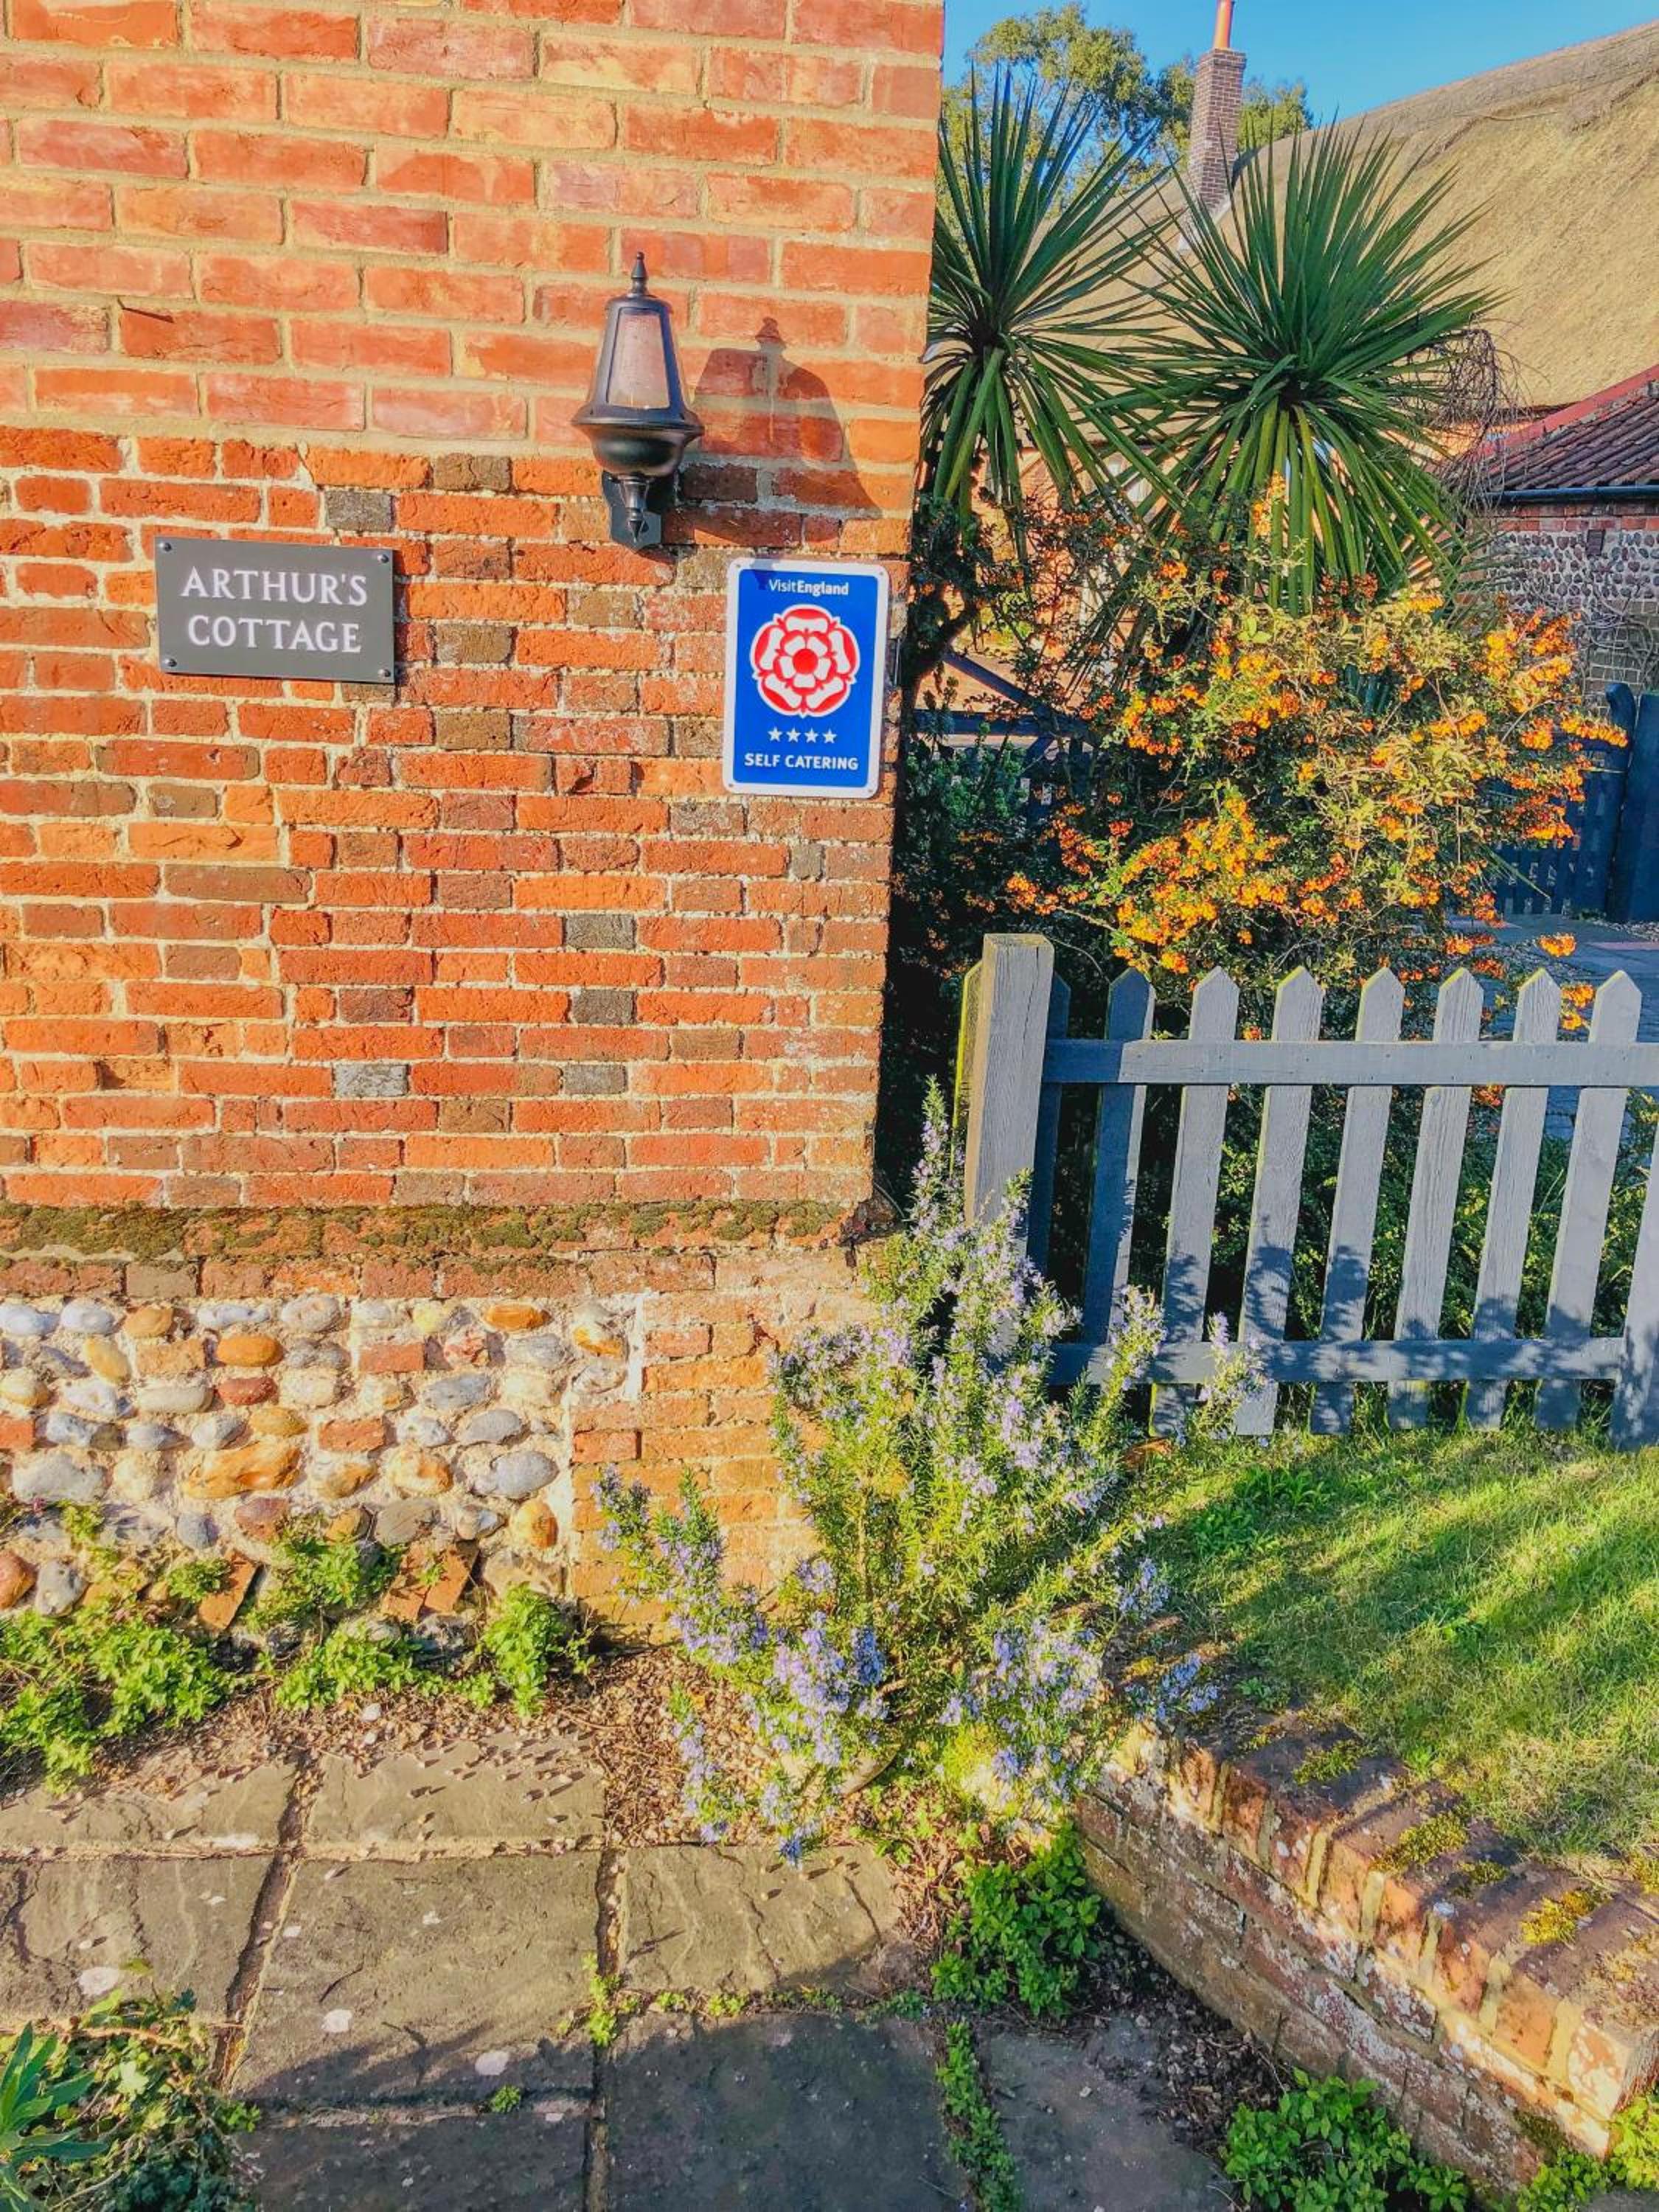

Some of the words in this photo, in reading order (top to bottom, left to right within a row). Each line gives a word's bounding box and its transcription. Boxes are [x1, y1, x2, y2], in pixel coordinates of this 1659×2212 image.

[181, 566, 367, 606] ARTHUR'S
[769, 579, 849, 597] VisitEngland
[188, 615, 361, 653] COTTAGE
[744, 753, 780, 767] SELF
[785, 755, 859, 771] CATERING
